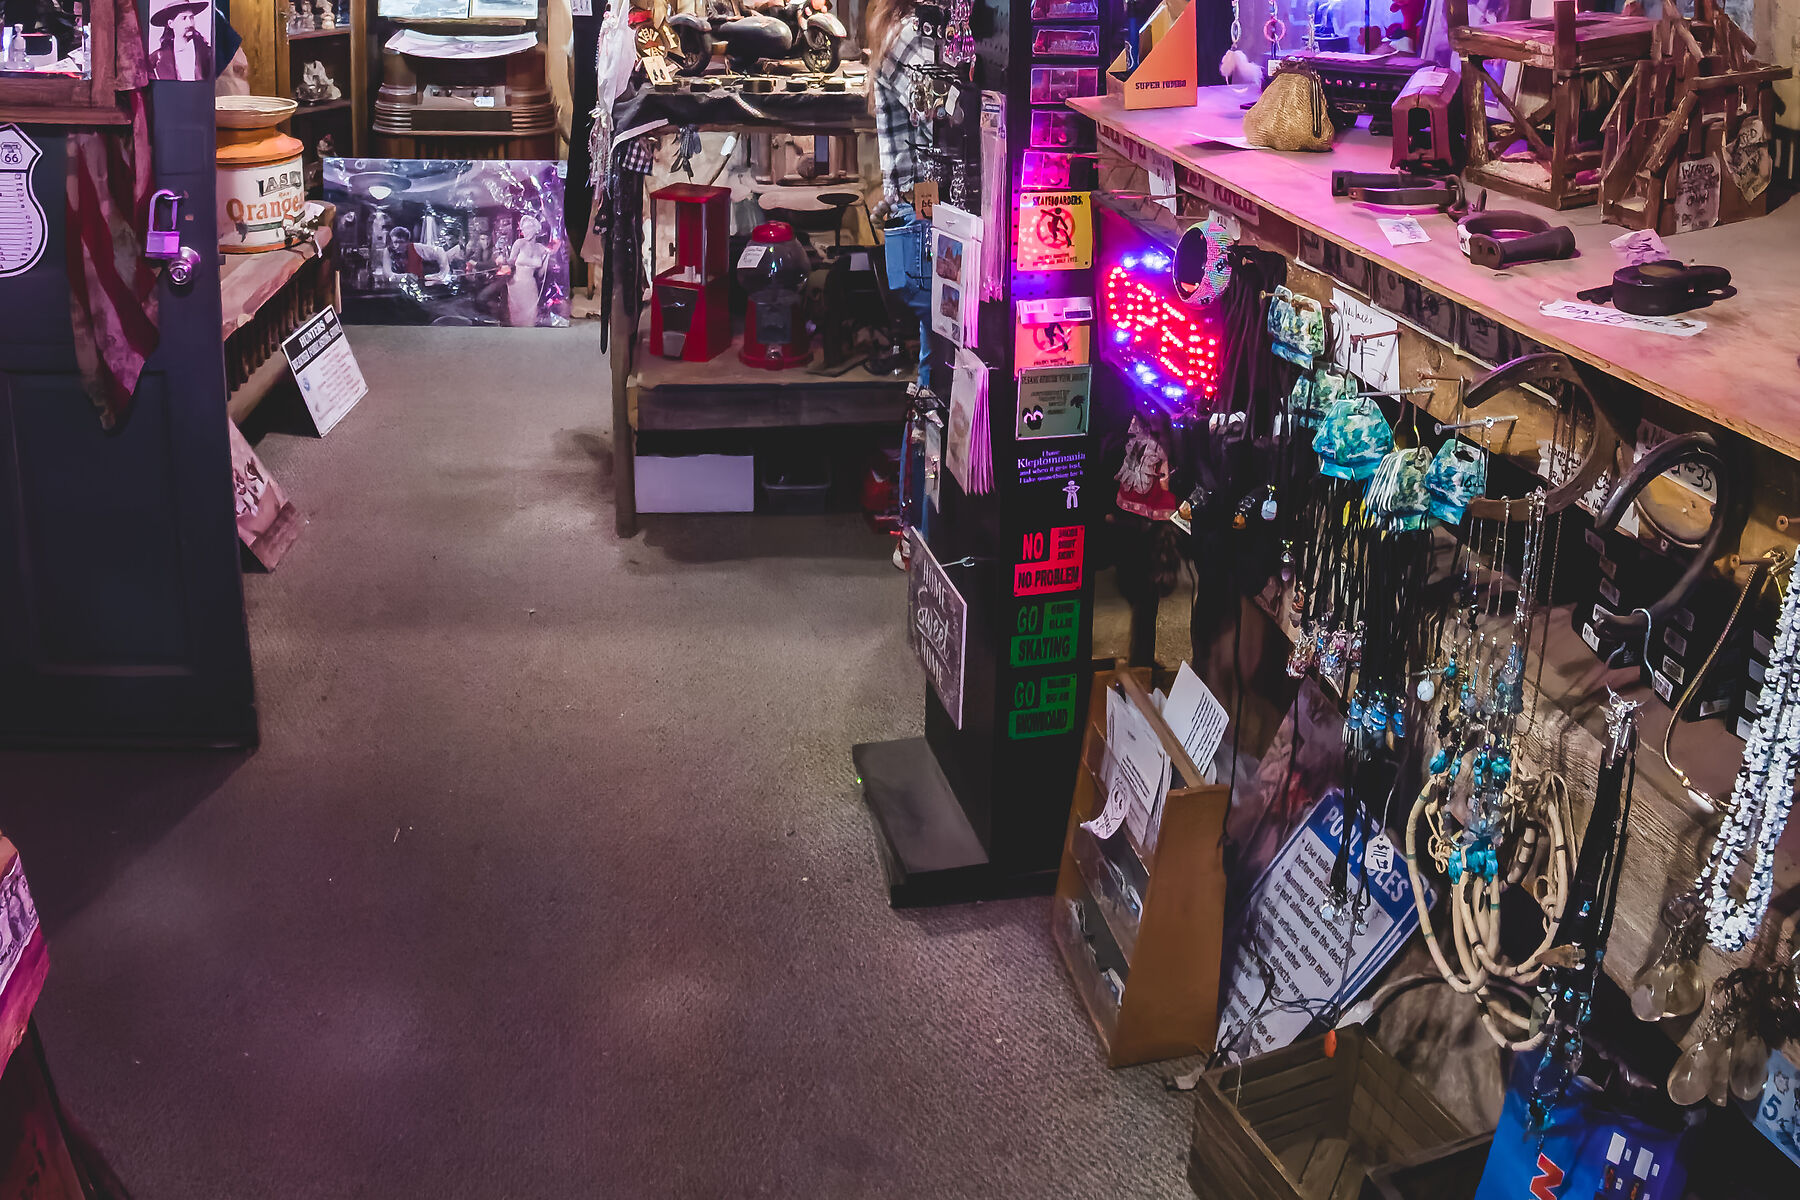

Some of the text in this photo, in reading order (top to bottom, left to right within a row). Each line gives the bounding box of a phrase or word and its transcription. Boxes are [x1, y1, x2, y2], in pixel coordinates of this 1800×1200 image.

[1135, 82, 1160, 90] SUPER
[4, 153, 19, 163] 66
[1022, 531, 1044, 561] NO
[1018, 566, 1079, 589] NO PROBLEM
[1017, 605, 1039, 633] GO
[1018, 635, 1071, 662] SKATING
[1014, 681, 1035, 709] GO
[1288, 899, 1314, 929] allowed
[1309, 926, 1322, 939] on
[1316, 934, 1332, 951] the
[1283, 948, 1303, 970] other
[1296, 942, 1320, 968] sharp
[1313, 961, 1336, 987] metal
[1266, 954, 1294, 985] objects
[1287, 980, 1302, 996] are
